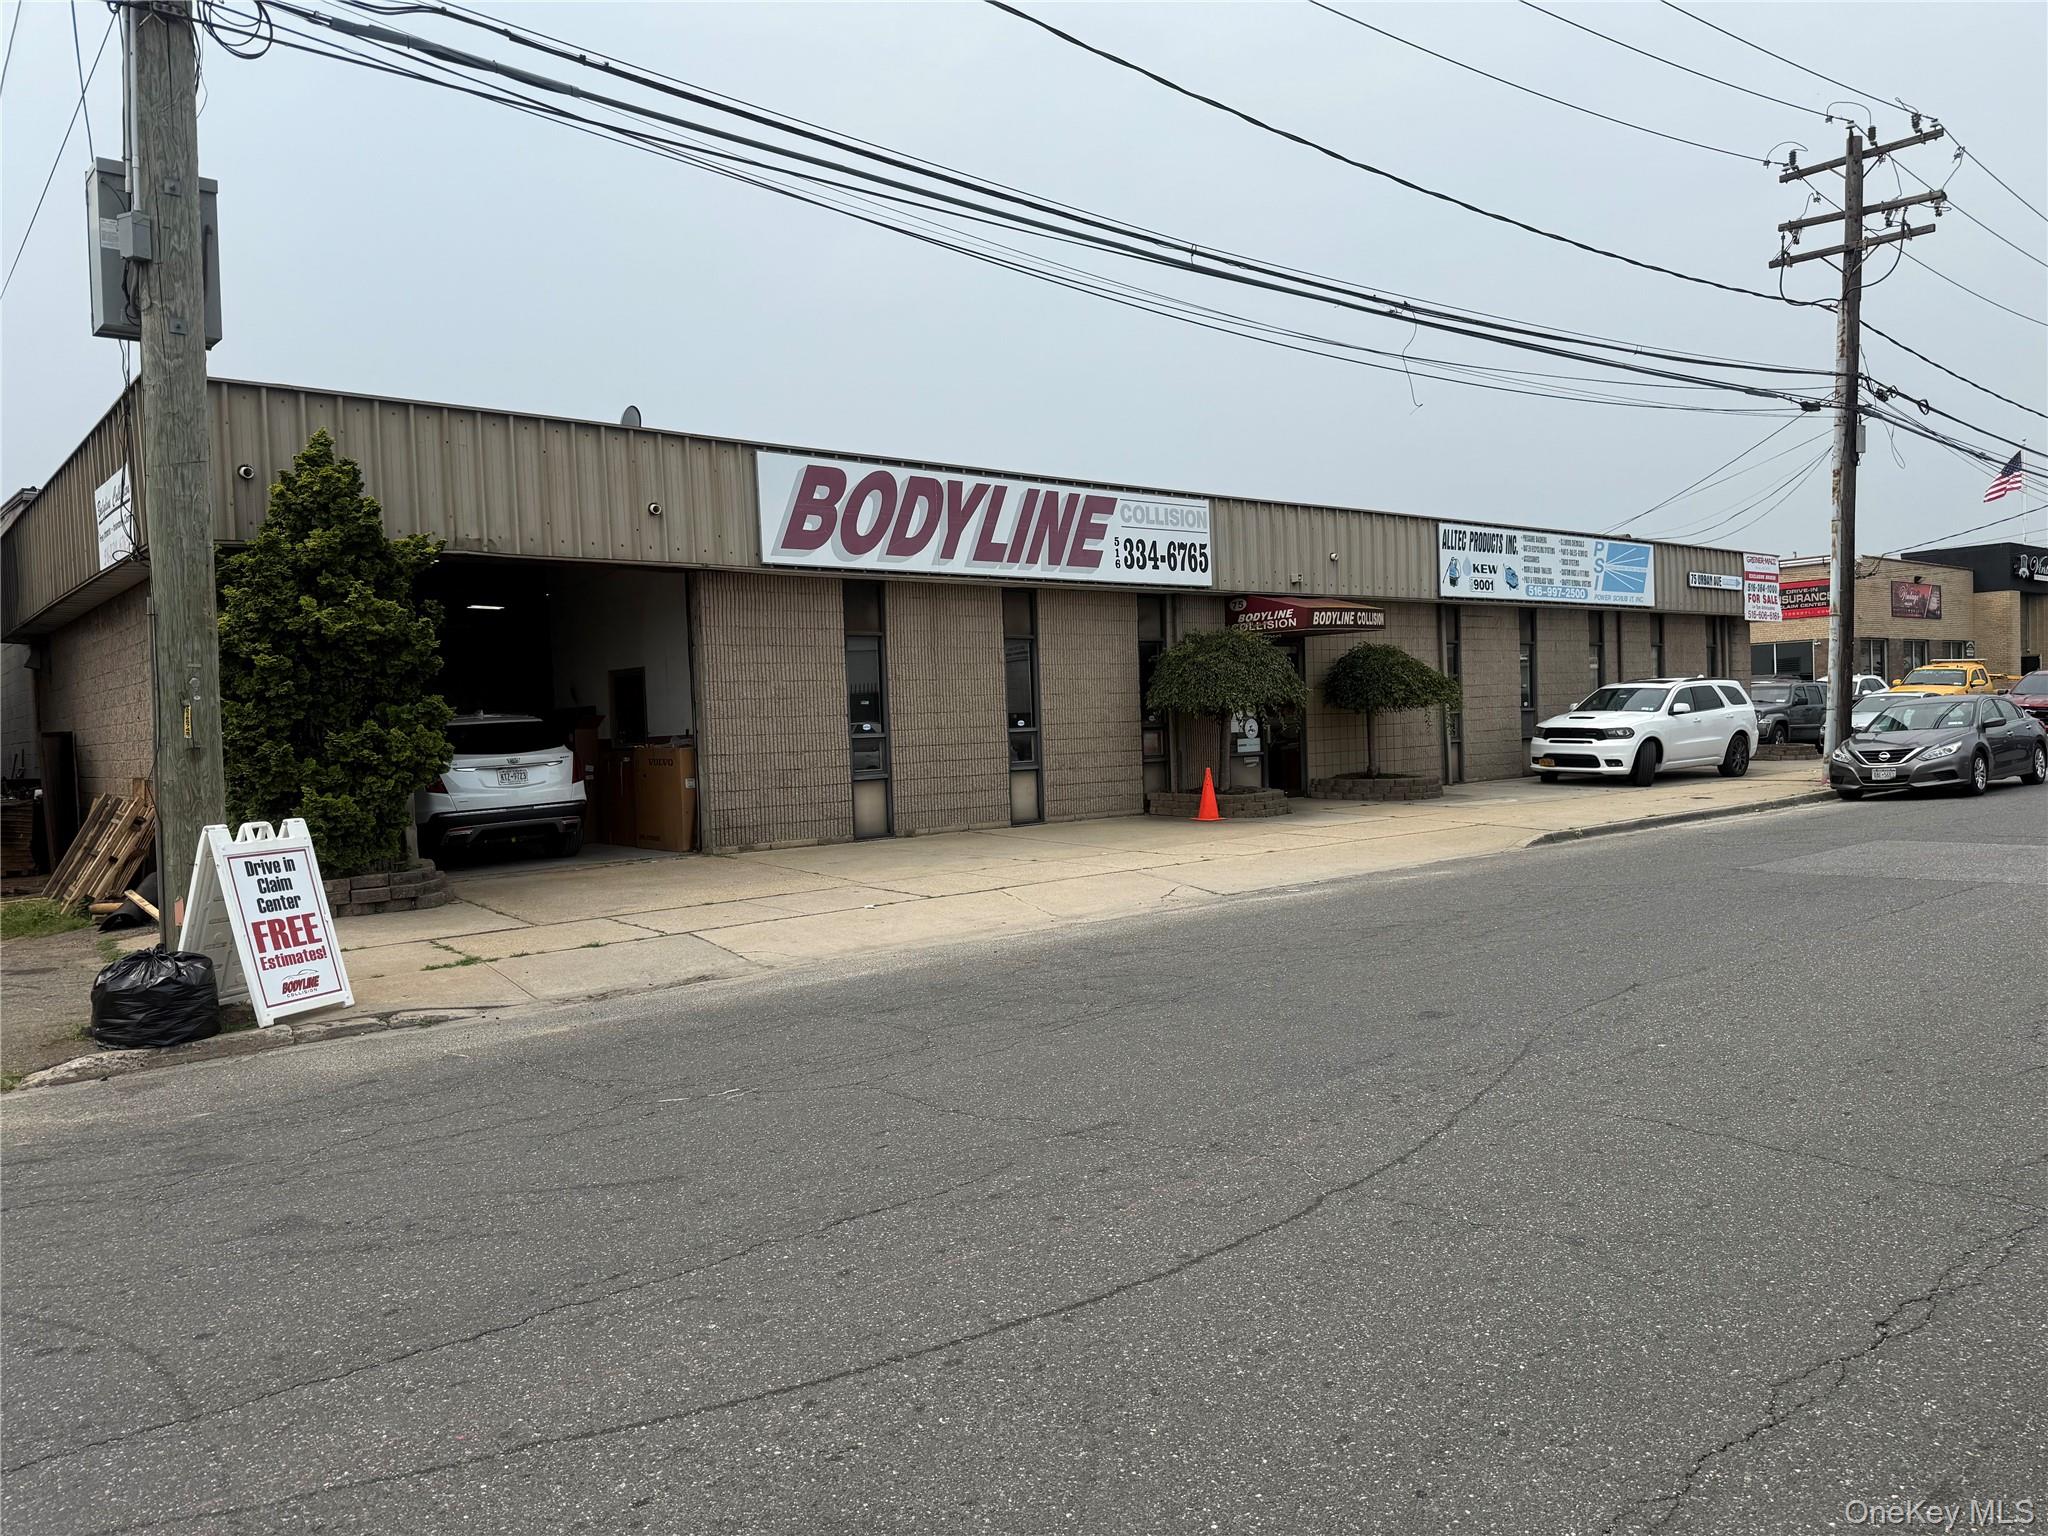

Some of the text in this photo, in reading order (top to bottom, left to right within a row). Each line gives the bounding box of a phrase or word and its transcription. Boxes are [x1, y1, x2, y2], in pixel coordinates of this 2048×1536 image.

[779, 464, 1118, 569] BODYLINE
[1120, 504, 1208, 529] COLLISION
[1469, 531, 1504, 554] PRODUCTS
[1505, 534, 1519, 555] INC.
[1123, 538, 1209, 573] 334-6765
[1472, 563, 1498, 575] KEW
[1473, 578, 1494, 592] 9001
[1691, 574, 1697, 585] 75
[1698, 574, 1713, 586] URBAN
[1528, 587, 1586, 599] 516-997-2500
[1748, 593, 1778, 605] FOR SALE
[1780, 591, 1830, 604] SURANCE
[1232, 600, 1244, 609] 75
[1238, 608, 1294, 623] BODYLINE
[1312, 611, 1385, 626] BODYLINE COLLISION
[648, 759, 674, 767] VOLVO
[244, 857, 296, 877] Drive in
[257, 876, 293, 894] Claim
[257, 893, 301, 914] Center
[251, 912, 323, 954] FREE
[260, 945, 328, 972] Estimates!
[282, 975, 320, 995] BODYLINE
[286, 988, 318, 998] COLLISION
